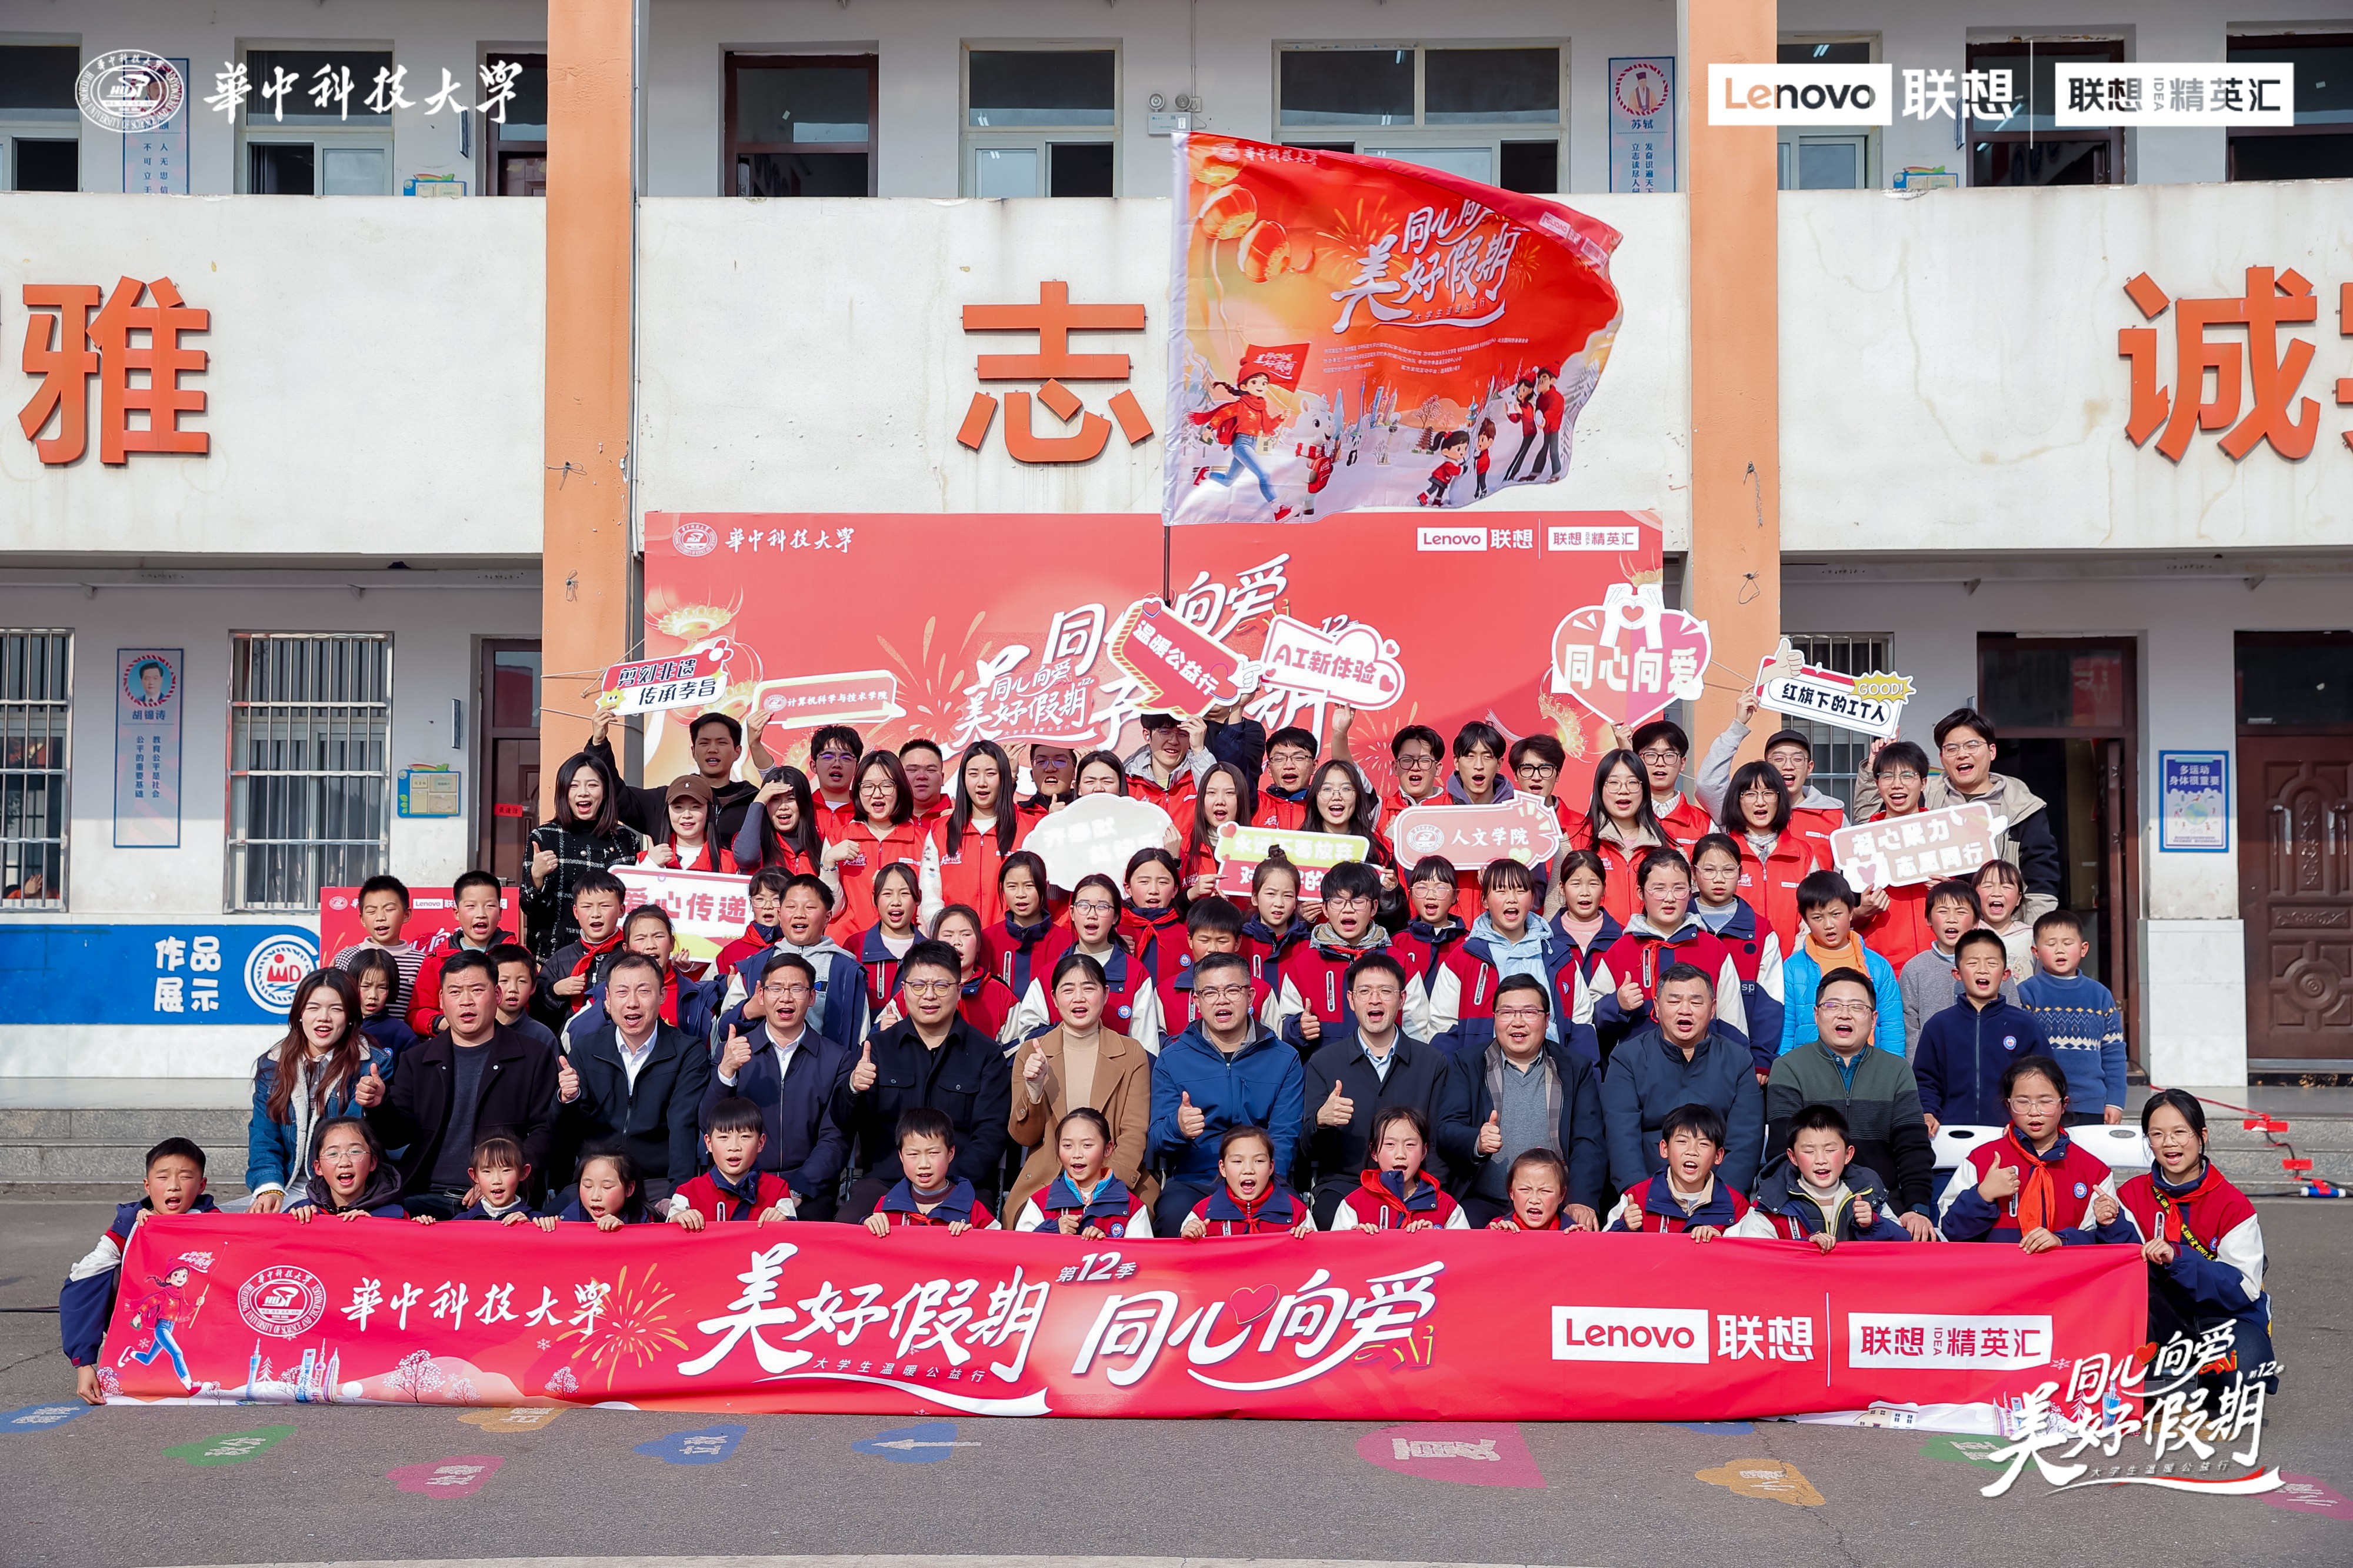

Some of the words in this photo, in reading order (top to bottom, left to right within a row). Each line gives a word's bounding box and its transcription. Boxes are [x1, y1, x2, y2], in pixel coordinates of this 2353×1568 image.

[1631, 119, 1654, 129] 苏轼
[1331, 222, 1522, 333] 美好假期
[18, 275, 211, 465] 雅
[957, 281, 1154, 465] 志
[2118, 266, 2353, 462] 诚
[1424, 533, 1481, 545] Lenovo
[1490, 529, 1533, 549] 联想
[1553, 532, 1581, 545] 联想
[1592, 532, 1634, 545] 精英汇
[1041, 553, 1289, 676] 同向爱
[618, 659, 696, 686] 剪刻非遗
[1132, 620, 1219, 695] 温暖公益行
[1272, 644, 1377, 684] AI新体验
[1565, 644, 1698, 693] 同心向爱
[639, 678, 716, 706] 传承孝昌
[788, 690, 888, 707] 计算机科学与技术学院
[1782, 683, 1885, 723] 红旗下的IT人
[1858, 683, 1904, 695] GOOD!
[132, 710, 166, 720] 胡锦涛
[951, 683, 1087, 748] 美好假期
[135, 736, 144, 798] 公平的重要基础
[152, 736, 161, 798] 教育公平是社会
[2169, 775, 2220, 785] 身体很重要
[2180, 765, 2209, 775] 多运动
[1233, 835, 1353, 860] 永远不要放弃
[1451, 826, 1529, 846] 人文学院
[1895, 842, 1984, 878] 志愿同行
[444, 899, 458, 908] 联
[624, 887, 746, 924] 爱心传递
[155, 935, 221, 972] 作品
[154, 976, 219, 1013] 展示
[1058, 1250, 1136, 1283] 第12季
[241, 1283, 255, 1312] HUAZHONG
[676, 1242, 1051, 1383] 美好假期
[245, 1310, 274, 1333] UNIVERSITY
[274, 1325, 280, 1333] OF
[282, 1322, 301, 1335] SCIENCE
[301, 1316, 312, 1328] AND
[1071, 1260, 1445, 1390] 同心向爱
[1565, 1317, 1695, 1350] Lenovo
[1717, 1314, 1814, 1362] 联想
[1861, 1326, 1925, 1357] 联想
[1947, 1328, 2042, 1358] 精英汇
[813, 1357, 985, 1382] 大学生温暖公益行
[679, 1435, 728, 1455] 立秋
[1392, 1438, 1501, 1461] 夏
